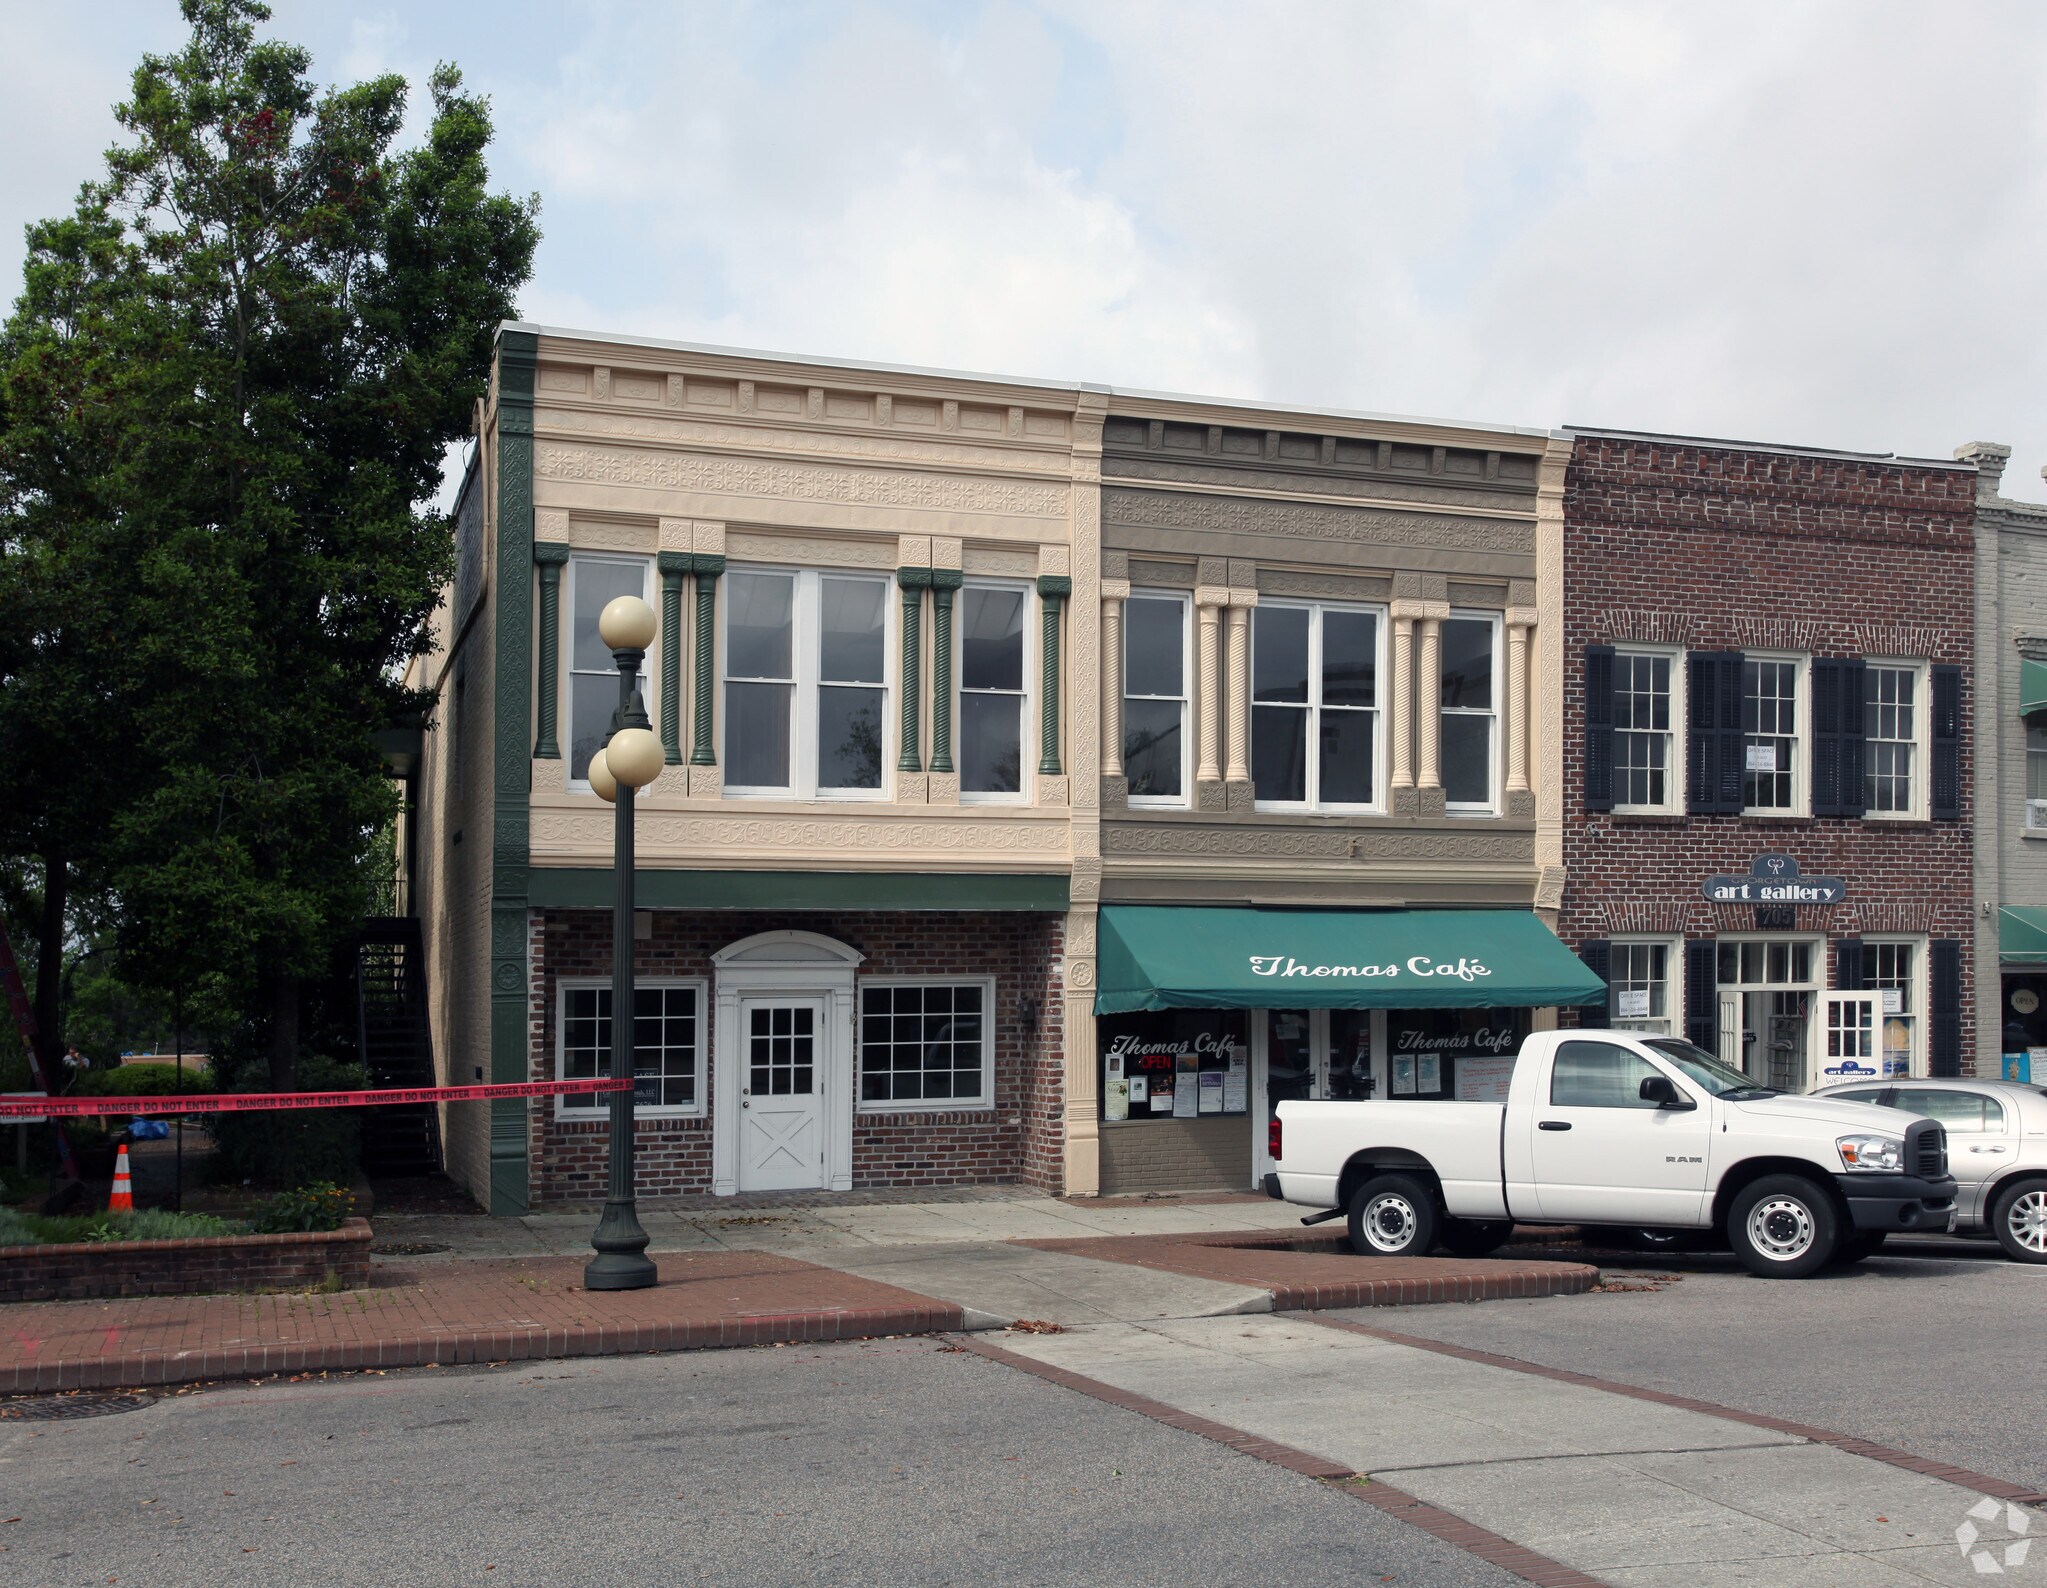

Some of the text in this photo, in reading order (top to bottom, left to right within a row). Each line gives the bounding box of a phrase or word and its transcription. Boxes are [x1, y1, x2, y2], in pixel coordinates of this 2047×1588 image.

[1714, 884, 1836, 900] art gallery
[1763, 908, 1792, 925] 705
[1249, 956, 1492, 981] Thomas Café
[1111, 1032, 1236, 1058] Thomas Café
[1398, 1028, 1512, 1053] Thomas Café
[1141, 1056, 1171, 1069] OPEN
[16, 1106, 38, 1114] NOT
[43, 1104, 79, 1114] ENTER
[97, 1103, 140, 1113] DANGER
[144, 1102, 157, 1111] DO
[162, 1101, 182, 1111] NOT
[186, 1100, 219, 1110] ENTER
[236, 1098, 276, 1108] DANGER
[280, 1098, 292, 1106] DO
[296, 1097, 316, 1106] NOT
[318, 1096, 349, 1105] ENTER
[365, 1094, 402, 1103] DANGER
[405, 1093, 417, 1101] DO
[420, 1091, 438, 1100] NOT
[441, 1090, 470, 1099] ENTER
[484, 1086, 519, 1097] DANGER
[521, 1086, 532, 1094] DO
[535, 1085, 550, 1093] NOT
[554, 1084, 580, 1092] ENTER
[593, 1081, 624, 1090] DANGER
